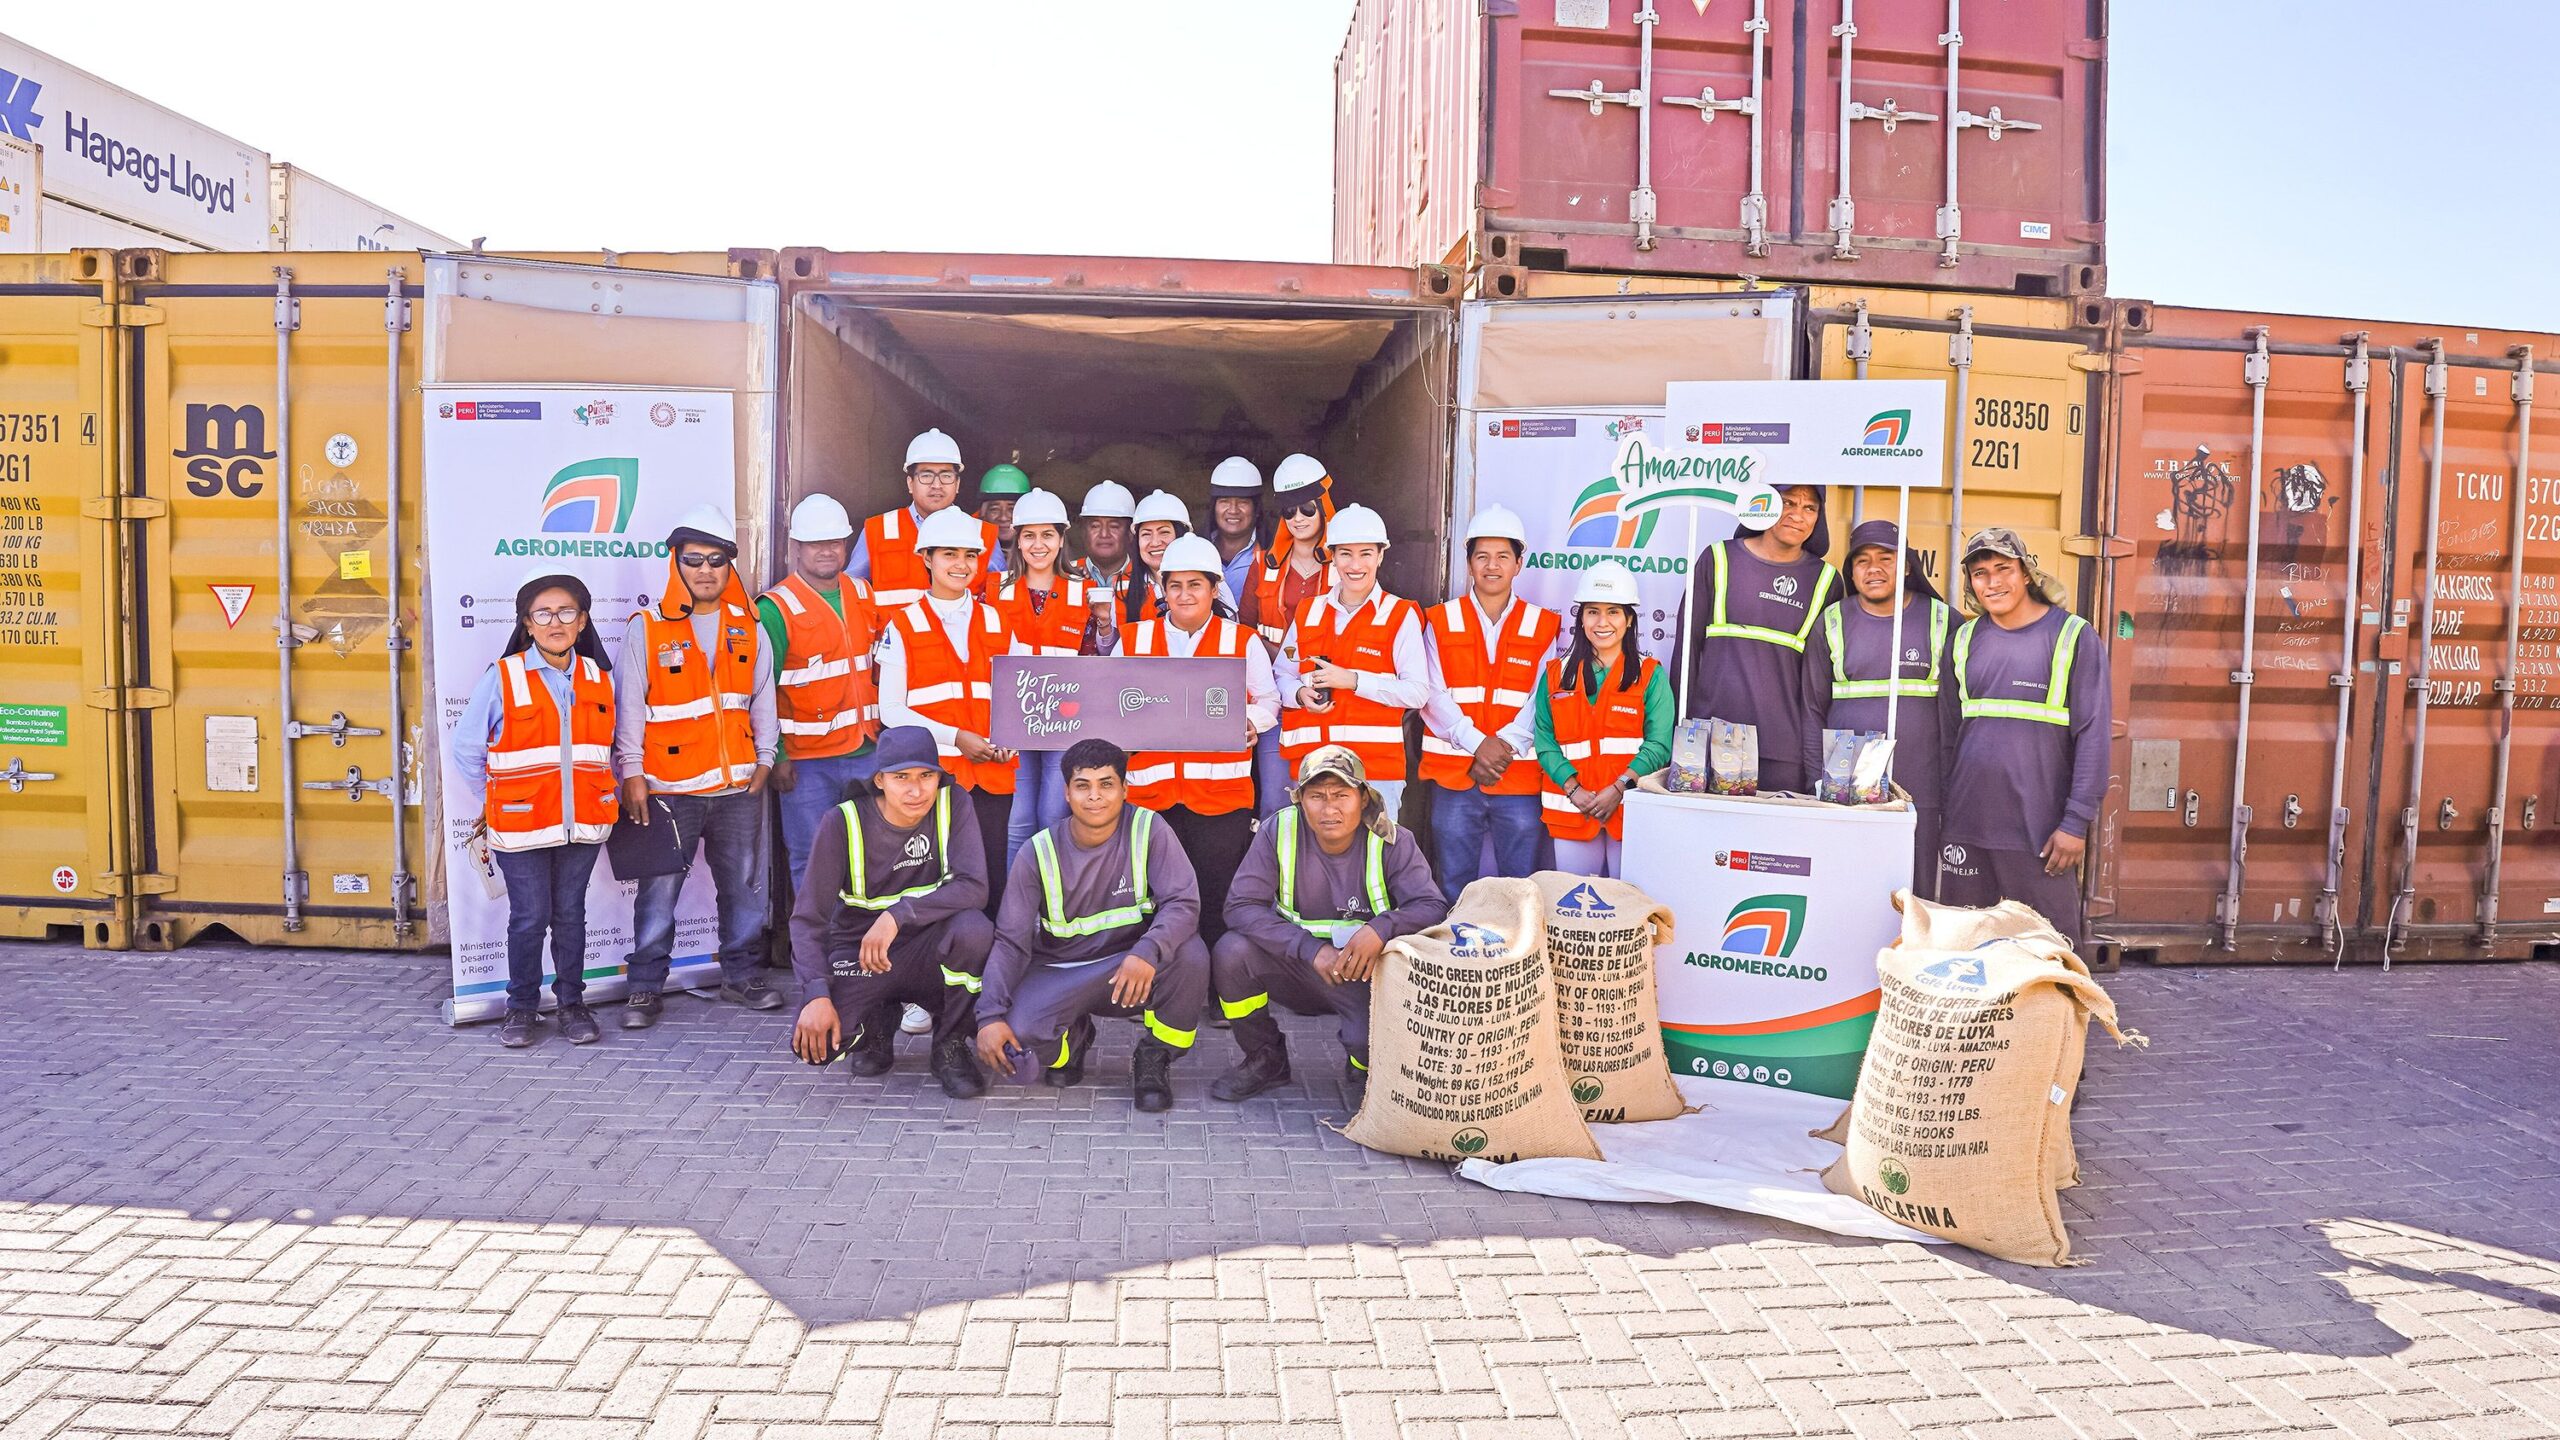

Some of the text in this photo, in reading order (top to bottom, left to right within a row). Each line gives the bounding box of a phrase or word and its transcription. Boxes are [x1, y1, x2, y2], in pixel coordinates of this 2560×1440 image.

[65, 110, 235, 214] Hapag-Lloyd
[2023, 225, 2048, 234] CIMC
[1974, 397, 2081, 433] 368350 0
[82, 415, 95, 443] 4
[1704, 429, 1720, 437] PERÚ
[1842, 447, 1923, 457] AGROMERCADO
[1971, 438, 2019, 470] 22G1
[1621, 440, 1756, 488] Amazonas
[2456, 472, 2503, 501] TCKU
[23, 497, 41, 511] KG
[29, 516, 43, 530] LB
[25, 535, 42, 549] KG
[495, 538, 669, 558] AGROMERCADO
[24, 554, 38, 568] LB
[25, 574, 42, 587] KG
[30, 592, 44, 606] LB
[1759, 591, 1788, 604] SERVISMAN
[26, 611, 58, 626] CU.M.
[2528, 610, 2559, 624] 2.230
[25, 630, 59, 645] CU.FT.
[1359, 646, 1381, 656] RANSA
[1511, 657, 1532, 667] RANSA
[1016, 669, 1080, 700] Yo Tomo
[2523, 679, 2547, 692] 33.2
[1021, 691, 1061, 717] Café
[1118, 687, 1170, 717] Perú
[1616, 705, 1638, 714] RANSA
[0, 706, 60, 718] Eco-Container
[1023, 714, 1082, 737] Peruano
[1556, 908, 1616, 920] Café Luya
[611, 926, 621, 934] de
[1562, 928, 1635, 943] GREEN COFFEE
[460, 940, 503, 951] Ministerio
[678, 940, 700, 948] Riego
[1598, 934, 1648, 957] DE MUJERES
[461, 951, 505, 963] Desarrollo
[1558, 952, 1643, 971] FLORES DE LUYA
[461, 965, 494, 976] y Riego
[1446, 963, 1520, 983] GREEN COFFEE
[1684, 951, 1828, 982] AGROMERCADO
[1407, 962, 1545, 999] ASOCIACIÓN DE MUJERES
[1591, 979, 1645, 1000] ORIGIN: PERU
[1901, 985, 1980, 1009] GREEN COFFEE
[1416, 984, 1538, 1015] LAS FLORES DE LUYA
[1596, 1002, 1616, 1014] 1193
[1929, 1007, 2014, 1024] DE MUJERES
[1424, 1009, 1510, 1026] DE JULIO LUYA LUYA
[1406, 1011, 1540, 1045] COUNTRY OF ORIGIN: PERU
[1889, 1013, 1995, 1040] FLORES DE LUYA
[1586, 1028, 1633, 1042] KG 152.119
[1420, 1034, 1530, 1060] Marks: 30 1193 1779
[1582, 1042, 1634, 1057] USE HOOKS
[1927, 1039, 2010, 1053] LUYA AMAZONAS
[1417, 1050, 1526, 1075] LOTE: 30 1193 1179
[1895, 1052, 1995, 1074] OF ORIGIN: PERU
[1400, 1064, 1519, 1091] Net Weight: 69 KG 152.119
[1912, 1076, 1973, 1088] 1193 1779
[1417, 1082, 1519, 1106] DO NOT USE HOOKS
[1907, 1091, 1966, 1105] 1193 1179
[1390, 1089, 1514, 1123] CAFÉ PRODUCIDO POR LAS FLORES DE
[1896, 1107, 1982, 1122] KG 152.119 LBS.
[1891, 1122, 1954, 1139] USE HOOKS
[1904, 1141, 1989, 1158] FLORES DE LUYA PARA
[1862, 1184, 1958, 1229] SUCAFINA
